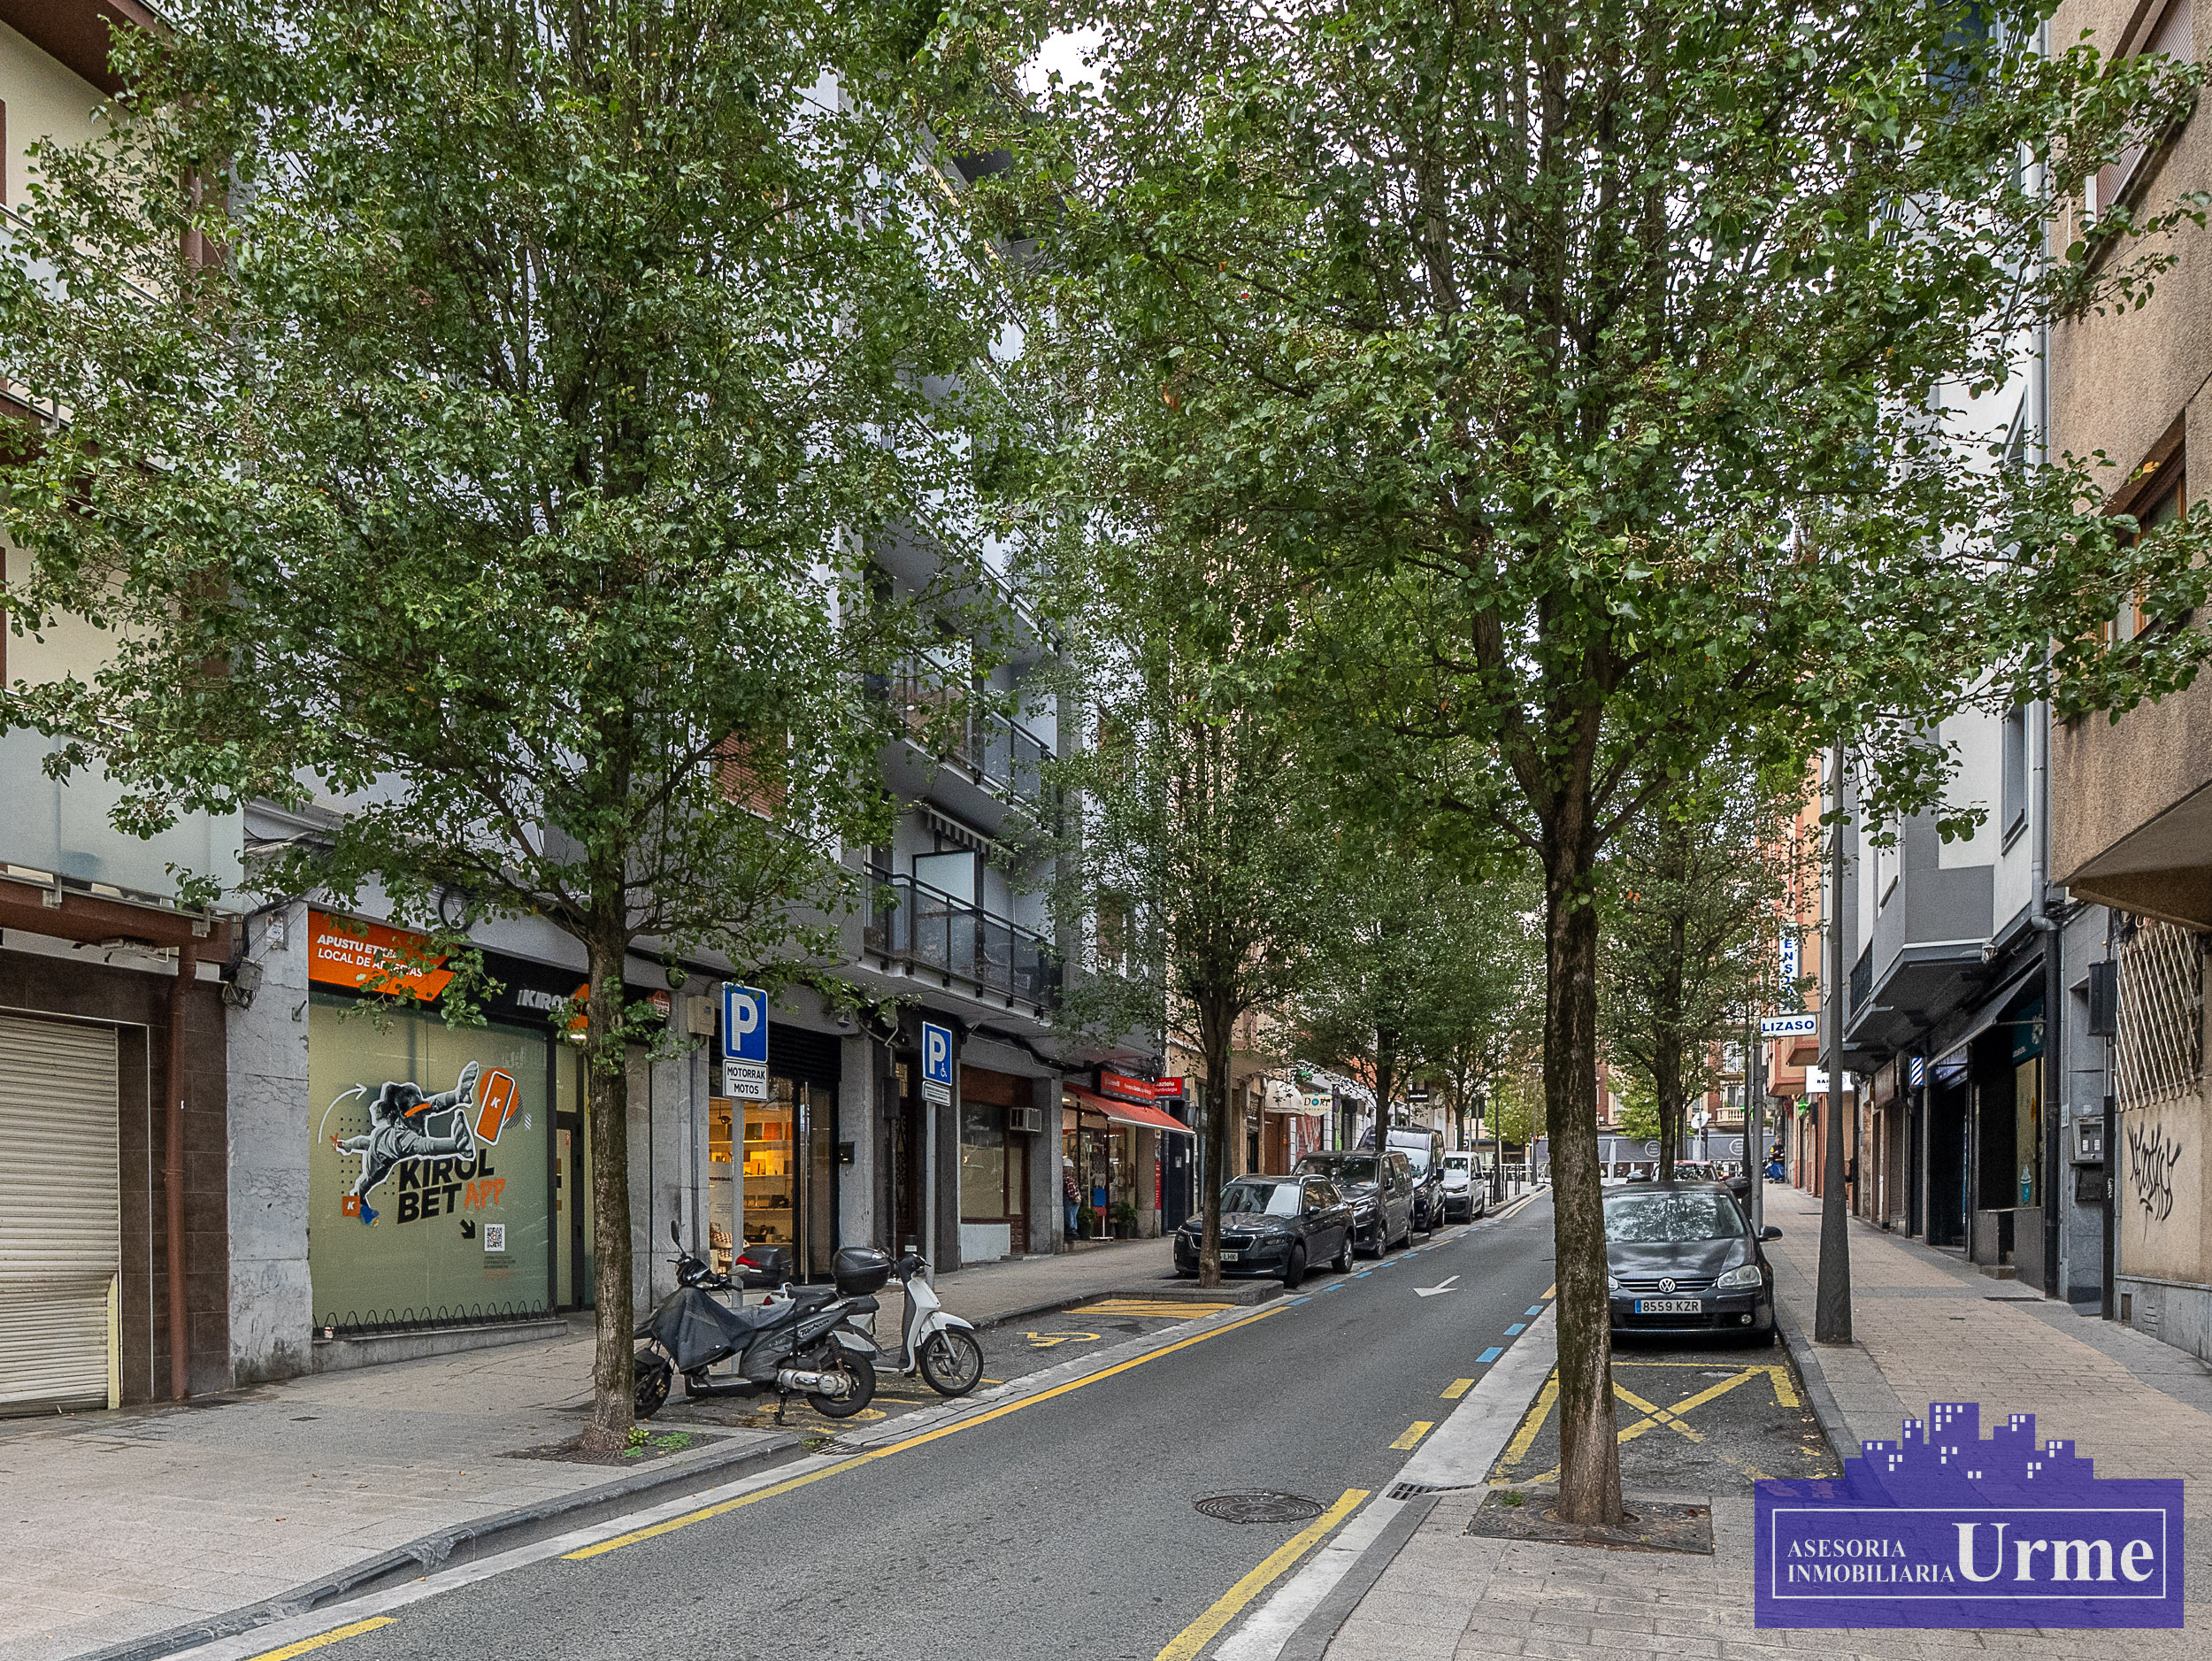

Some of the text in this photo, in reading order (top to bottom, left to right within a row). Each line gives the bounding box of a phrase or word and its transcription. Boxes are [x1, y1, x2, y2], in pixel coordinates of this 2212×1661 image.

[317, 934, 364, 952] APUSTU
[318, 948, 354, 964] LOCAL
[356, 956, 372, 967] DE
[731, 992, 758, 1051] P
[1762, 1020, 1815, 1032] LIZASO
[929, 1030, 946, 1074] P
[726, 1066, 765, 1080] MOTORRAK
[733, 1083, 759, 1095] MOTOS
[490, 1096, 501, 1108] K
[399, 1149, 495, 1192] KIROL
[397, 1178, 506, 1224] BET APP
[1643, 1301, 1699, 1311] 8559 KZR
